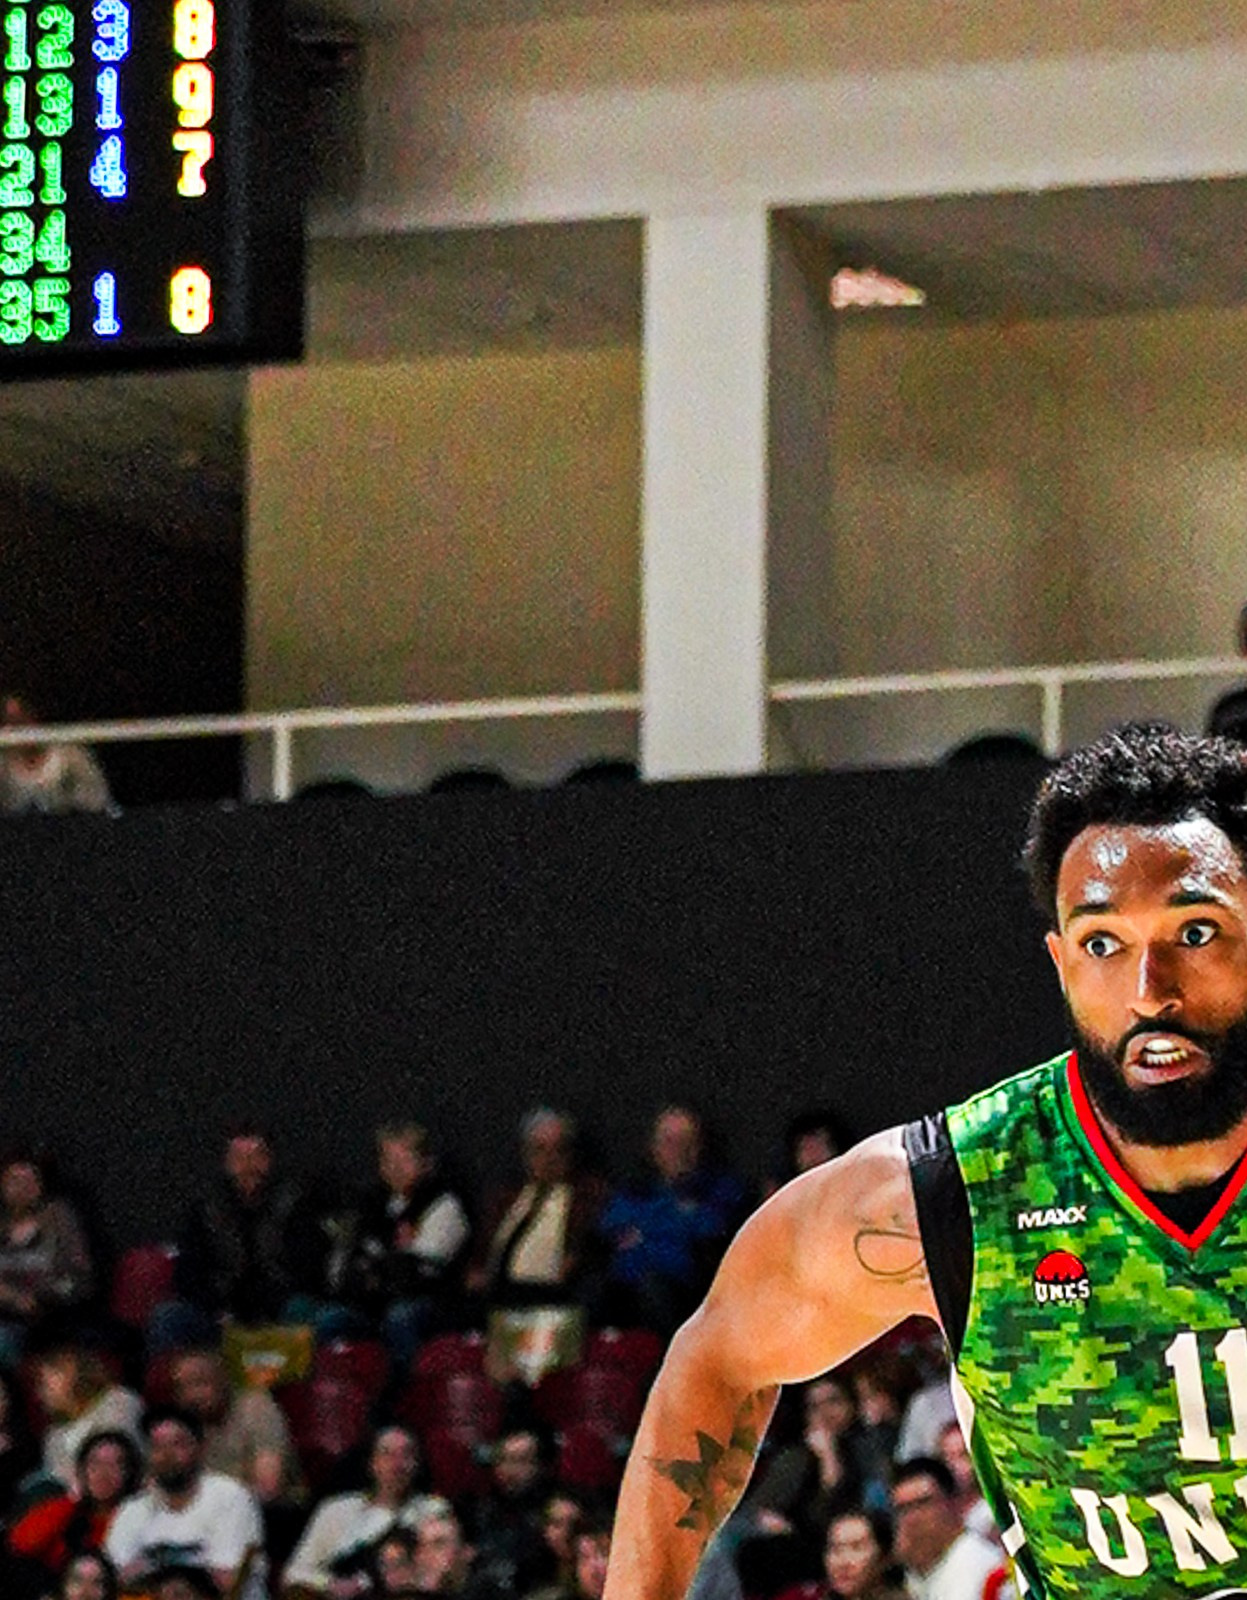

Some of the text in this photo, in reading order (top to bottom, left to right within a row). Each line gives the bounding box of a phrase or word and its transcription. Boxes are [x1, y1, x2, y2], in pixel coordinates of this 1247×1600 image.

[4, 0, 216, 71] 12 3 8
[3, 62, 214, 139] 13 1 9
[0, 130, 214, 207] 21 4 7
[93, 271, 121, 336] 1
[170, 266, 213, 334] 8
[1018, 1205, 1087, 1230] MAXX
